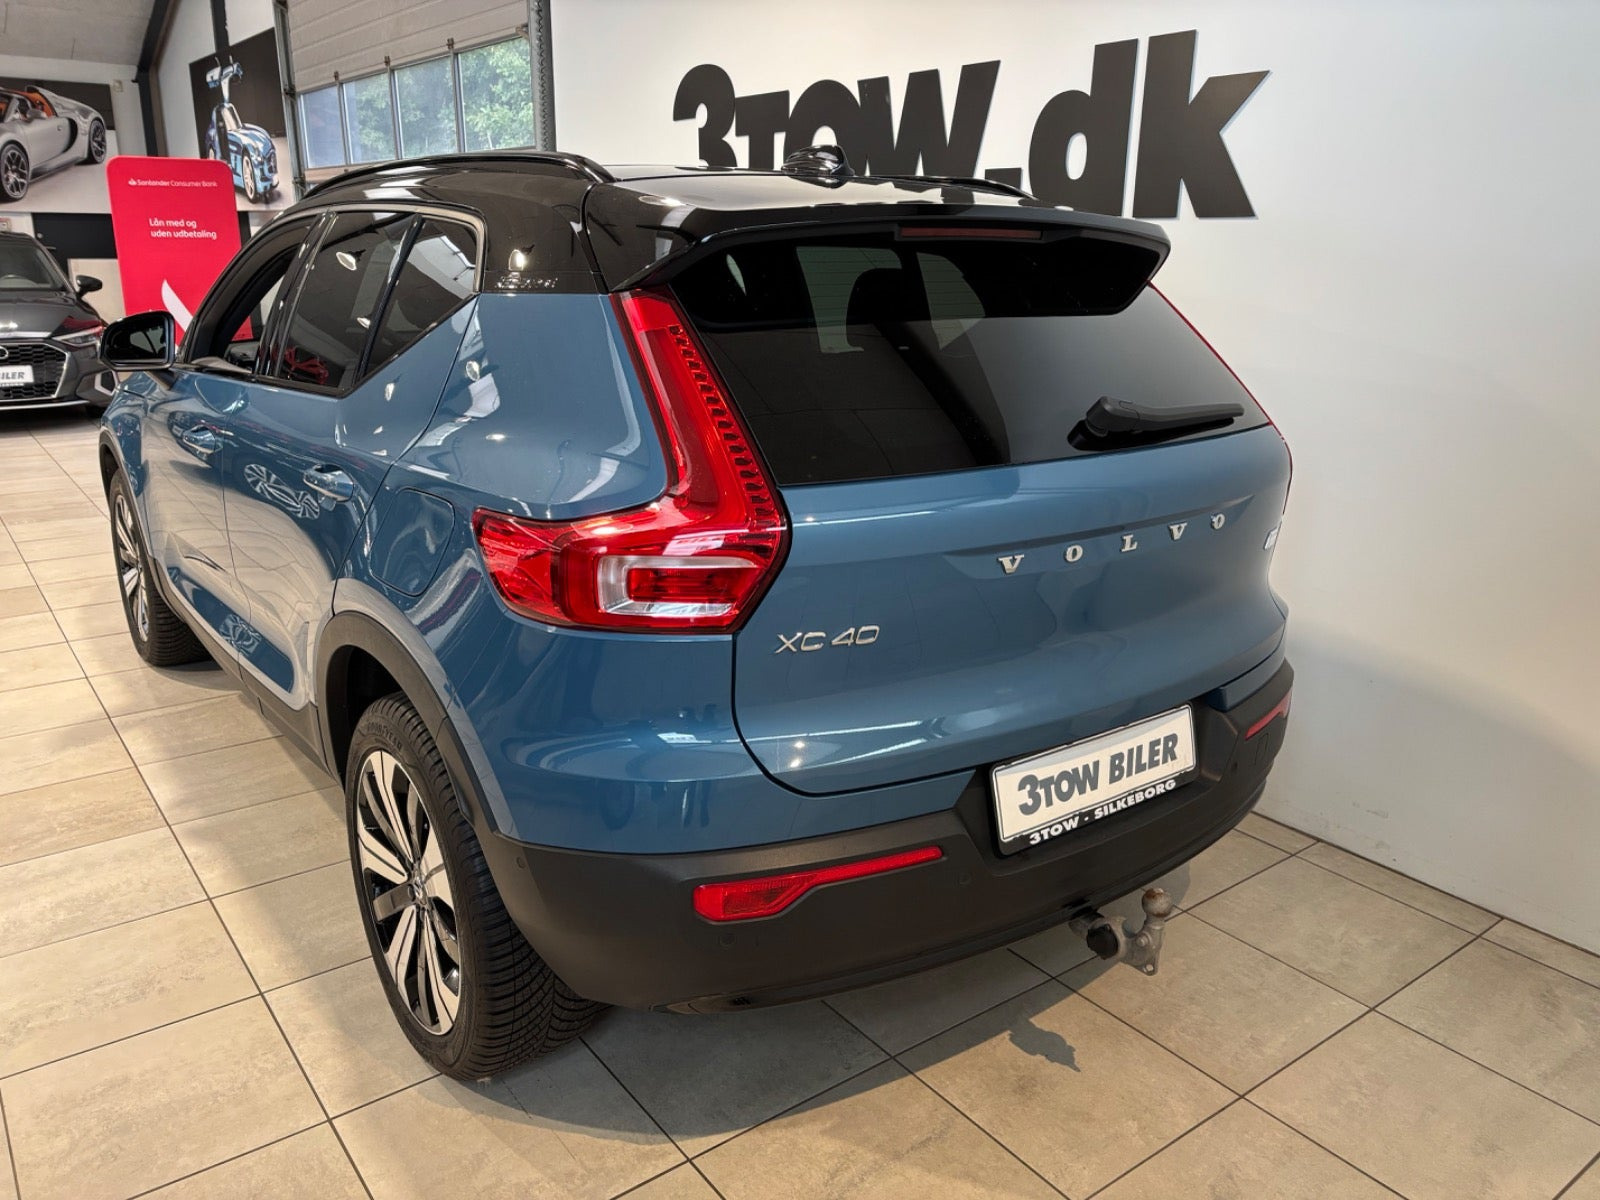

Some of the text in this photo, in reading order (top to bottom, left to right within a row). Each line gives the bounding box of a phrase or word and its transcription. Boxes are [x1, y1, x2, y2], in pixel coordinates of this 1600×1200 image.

[137, 179, 170, 187] Santander
[149, 217, 164, 227] Lån
[166, 219, 185, 227] med
[151, 230, 217, 240] uden udbetaling
[0, 371, 25, 380] ILER
[998, 513, 1226, 575] VOLVO
[1017, 733, 1179, 816] 3TOW BILER
[1029, 815, 1080, 845] 3TOW
[1094, 779, 1176, 820] SILKEBORG
